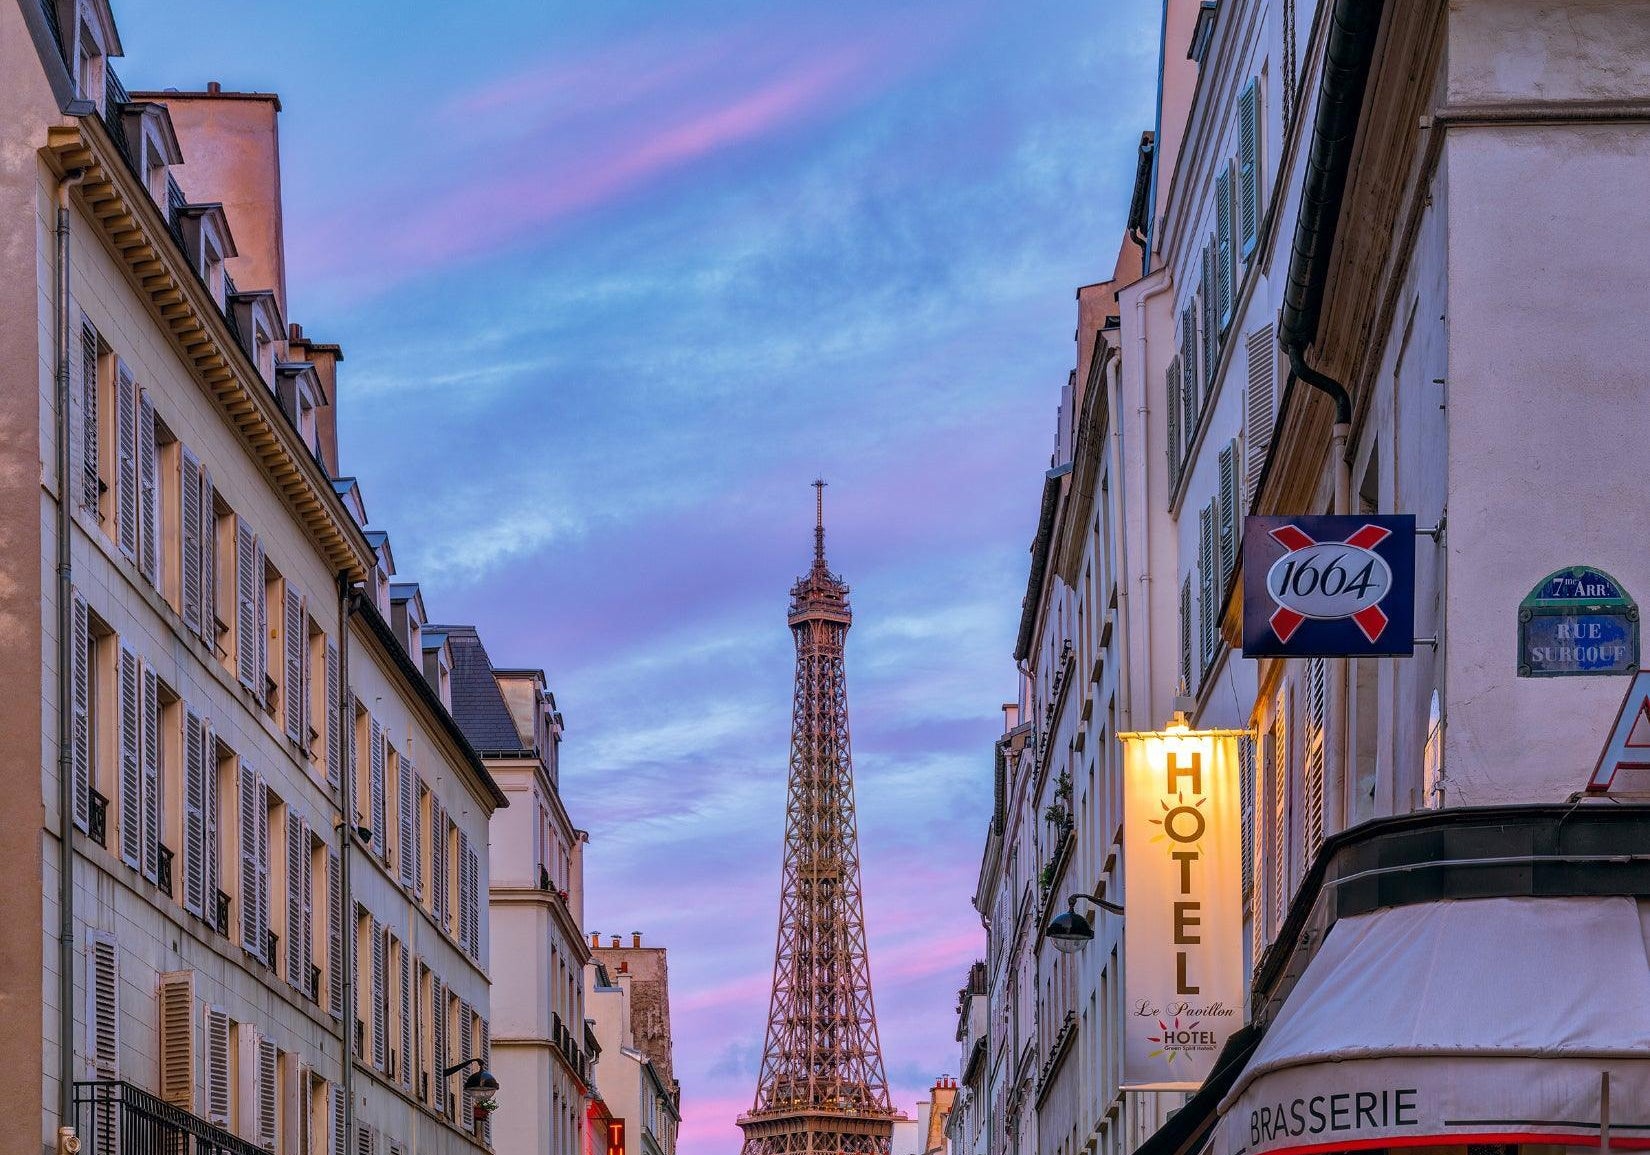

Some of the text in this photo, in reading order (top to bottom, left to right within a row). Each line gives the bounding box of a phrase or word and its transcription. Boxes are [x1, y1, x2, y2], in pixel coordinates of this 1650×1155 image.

[1278, 553, 1380, 600] 1664
[1557, 623, 1602, 639] RUE
[1532, 645, 1626, 662] SURCOUF
[1164, 752, 1206, 995] HOTEL
[1134, 999, 1235, 1017] Le Pavillon
[1164, 1031, 1217, 1044] HOTEL
[1250, 1089, 1418, 1146] BRASSERIE
